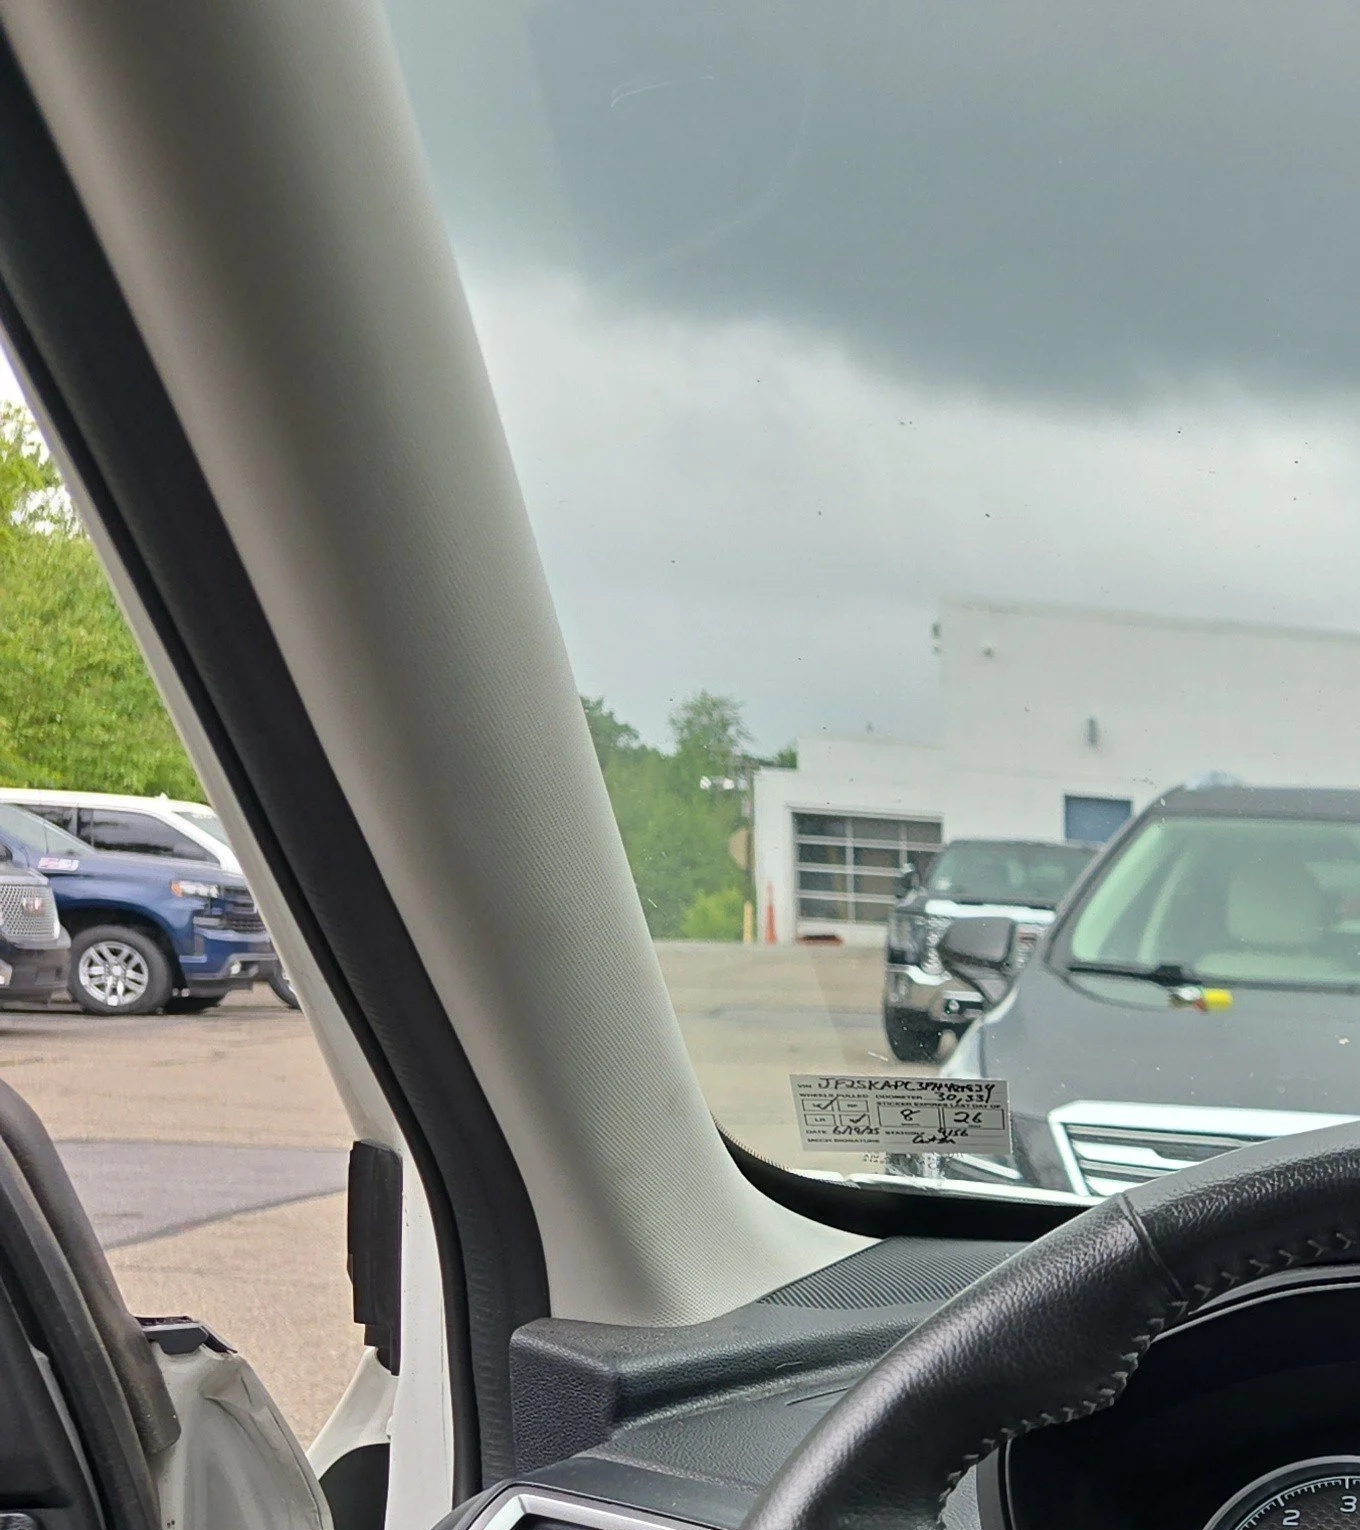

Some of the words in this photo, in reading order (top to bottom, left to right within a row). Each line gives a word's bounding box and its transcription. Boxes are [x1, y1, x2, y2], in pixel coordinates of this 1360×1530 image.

[954, 1111, 982, 1124] 26
[1341, 1496, 1357, 1514] 3
[1283, 1510, 1300, 1526] 2
